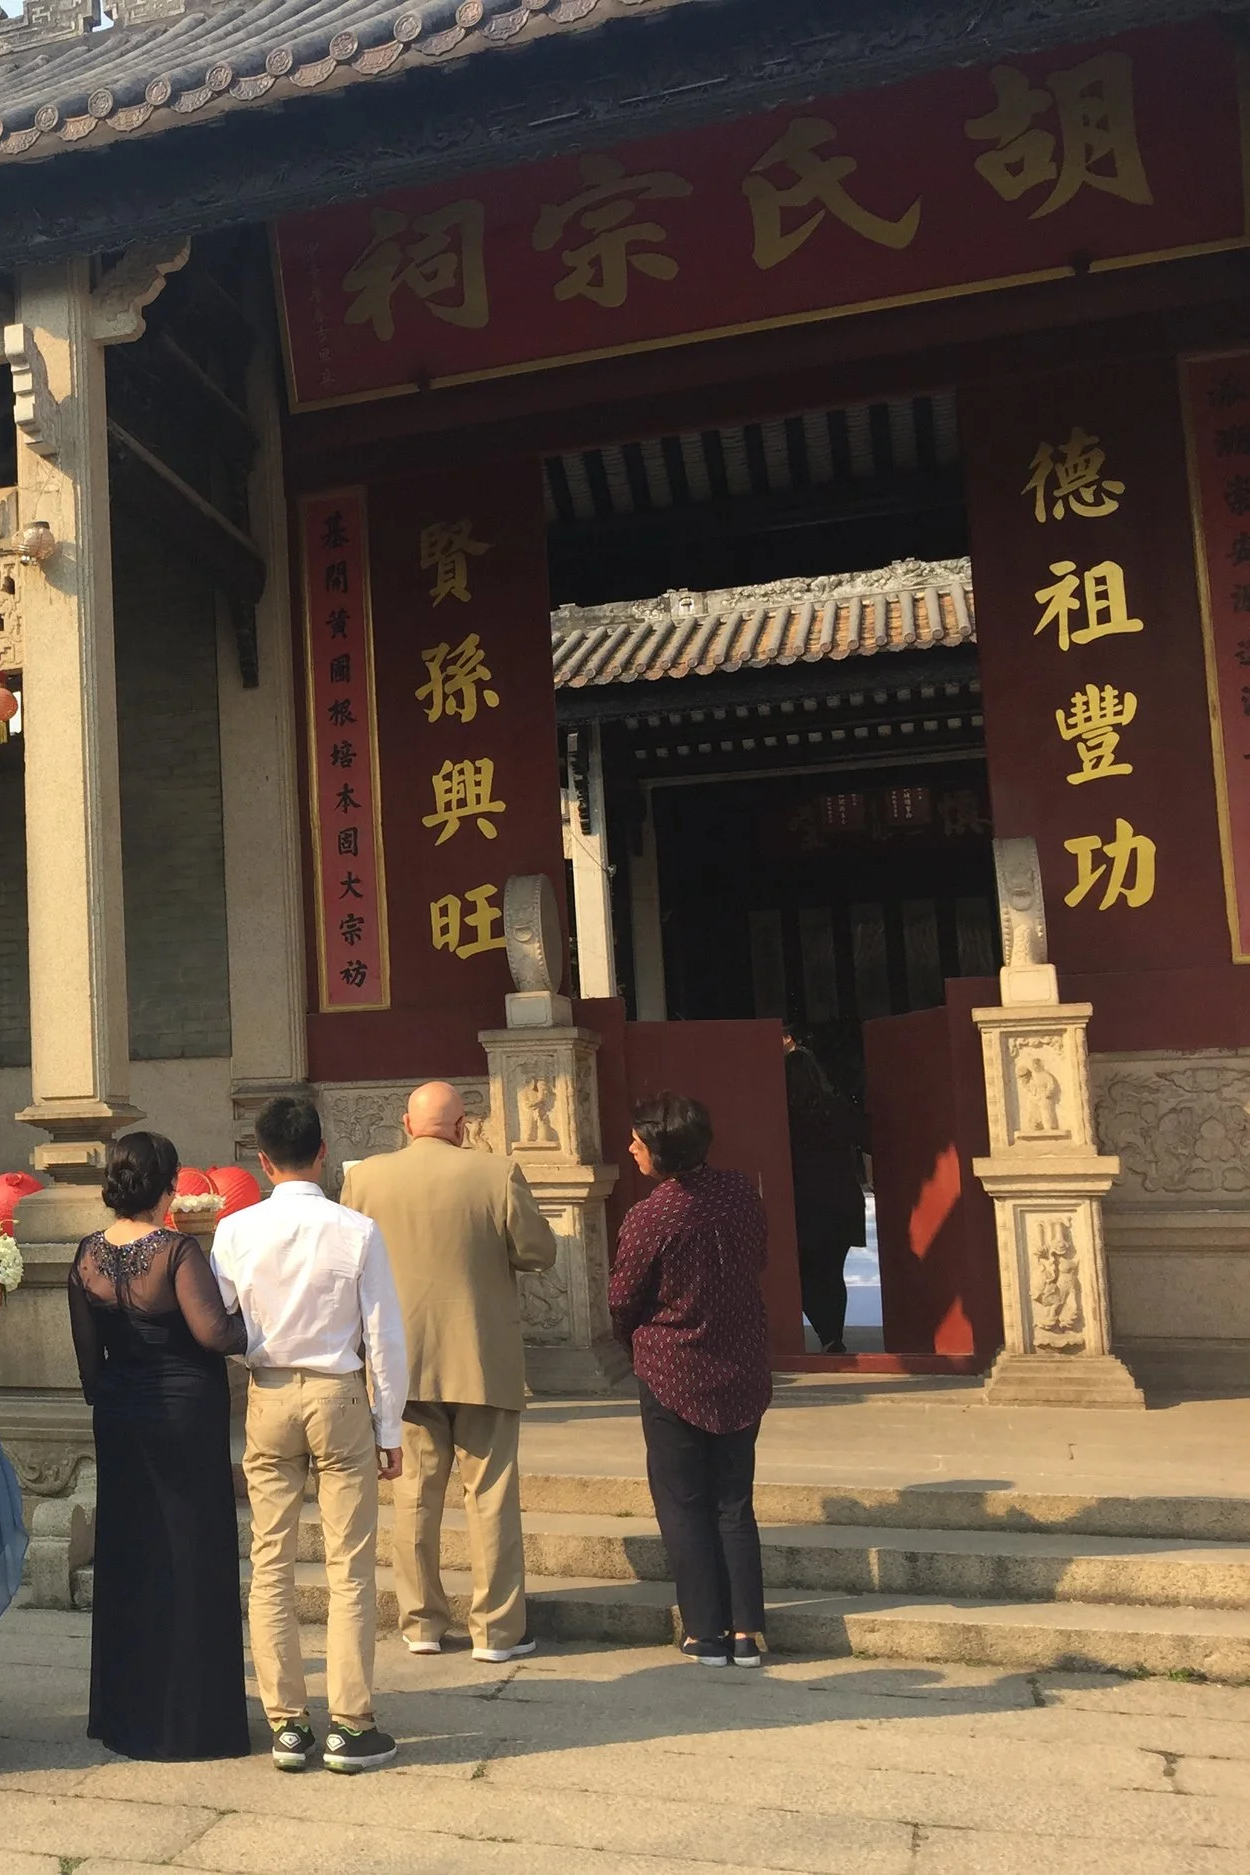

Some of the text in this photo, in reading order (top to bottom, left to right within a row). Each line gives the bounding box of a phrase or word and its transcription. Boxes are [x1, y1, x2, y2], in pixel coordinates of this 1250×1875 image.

[415, 519, 507, 960] 賢孫興旺
[1020, 426, 1158, 911] 德祖豐功
